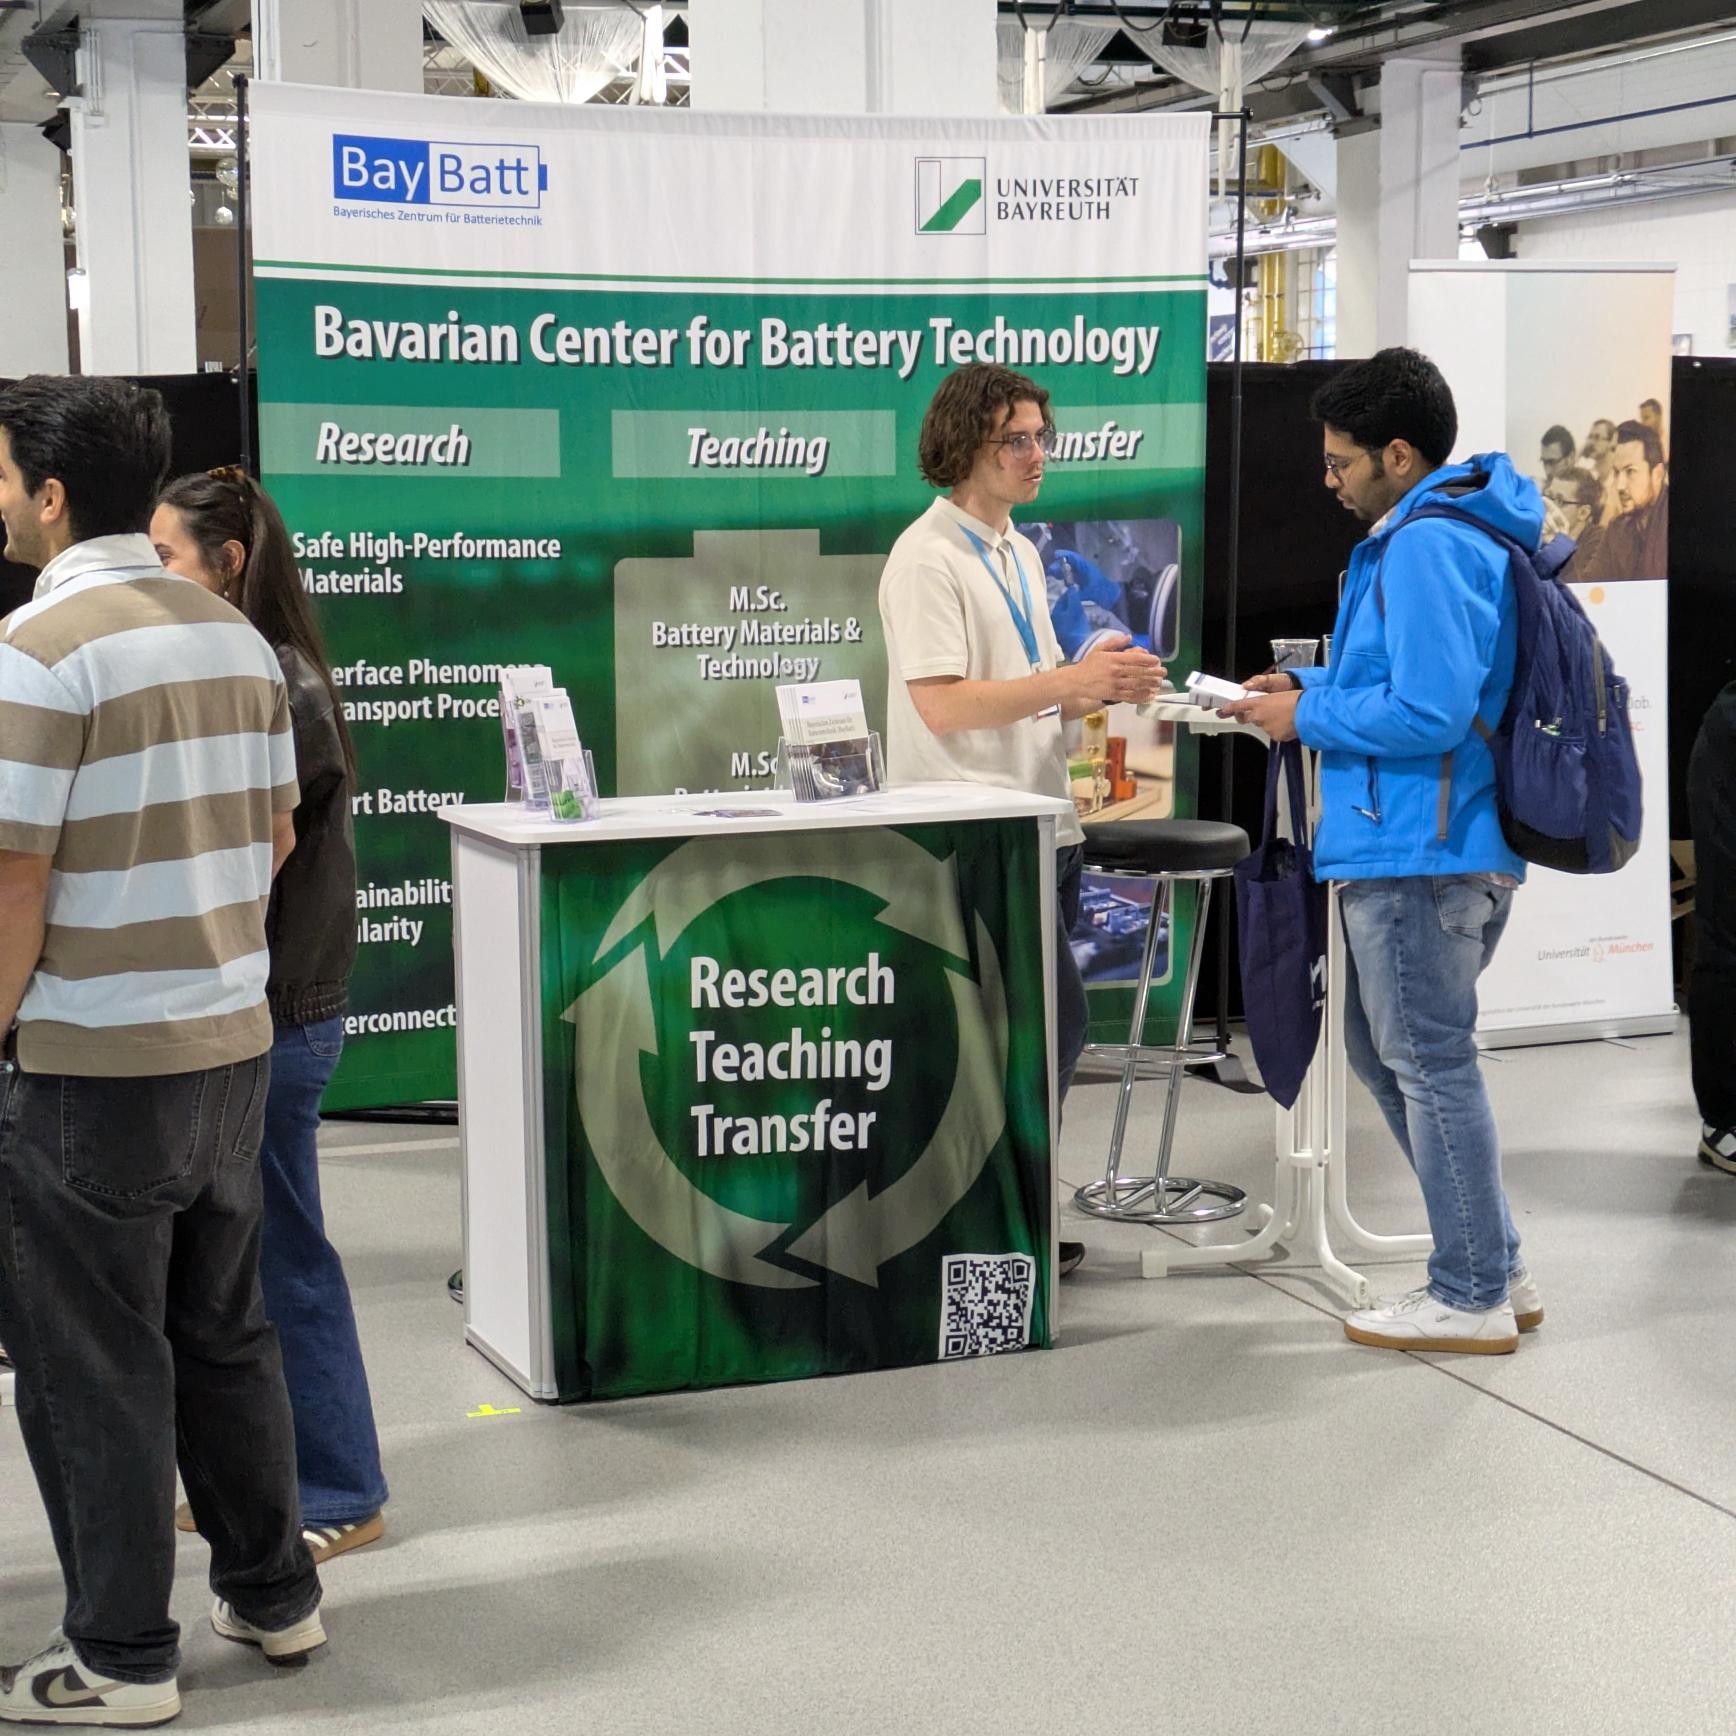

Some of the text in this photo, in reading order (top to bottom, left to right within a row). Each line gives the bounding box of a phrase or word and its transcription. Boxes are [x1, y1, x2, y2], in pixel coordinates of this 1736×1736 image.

[997, 176, 1139, 198] UNIVERSITÄT
[333, 206, 542, 226] Bayerisches Zentrum für Batterietechnik
[997, 201, 1110, 220] BAYREUTH
[315, 305, 1160, 377] Bavarian Center for Battery Technology
[316, 422, 469, 464] Research
[687, 427, 828, 474] Teaching
[1050, 421, 1142, 459] ansfer
[292, 531, 561, 565] Safe High-Performance
[730, 585, 787, 611] M.Sc.
[652, 616, 862, 650] Battery Materials &
[332, 658, 546, 686] erface Phenom
[697, 652, 820, 681] Technology
[341, 693, 500, 726] ansport Proce
[352, 792, 373, 815] rt
[356, 878, 454, 909] ainabilit
[358, 915, 423, 947] larity
[690, 952, 895, 1009] Research
[342, 1003, 456, 1035] erconnect
[689, 1026, 892, 1091] Teaching
[690, 1099, 876, 1157] Transfer
